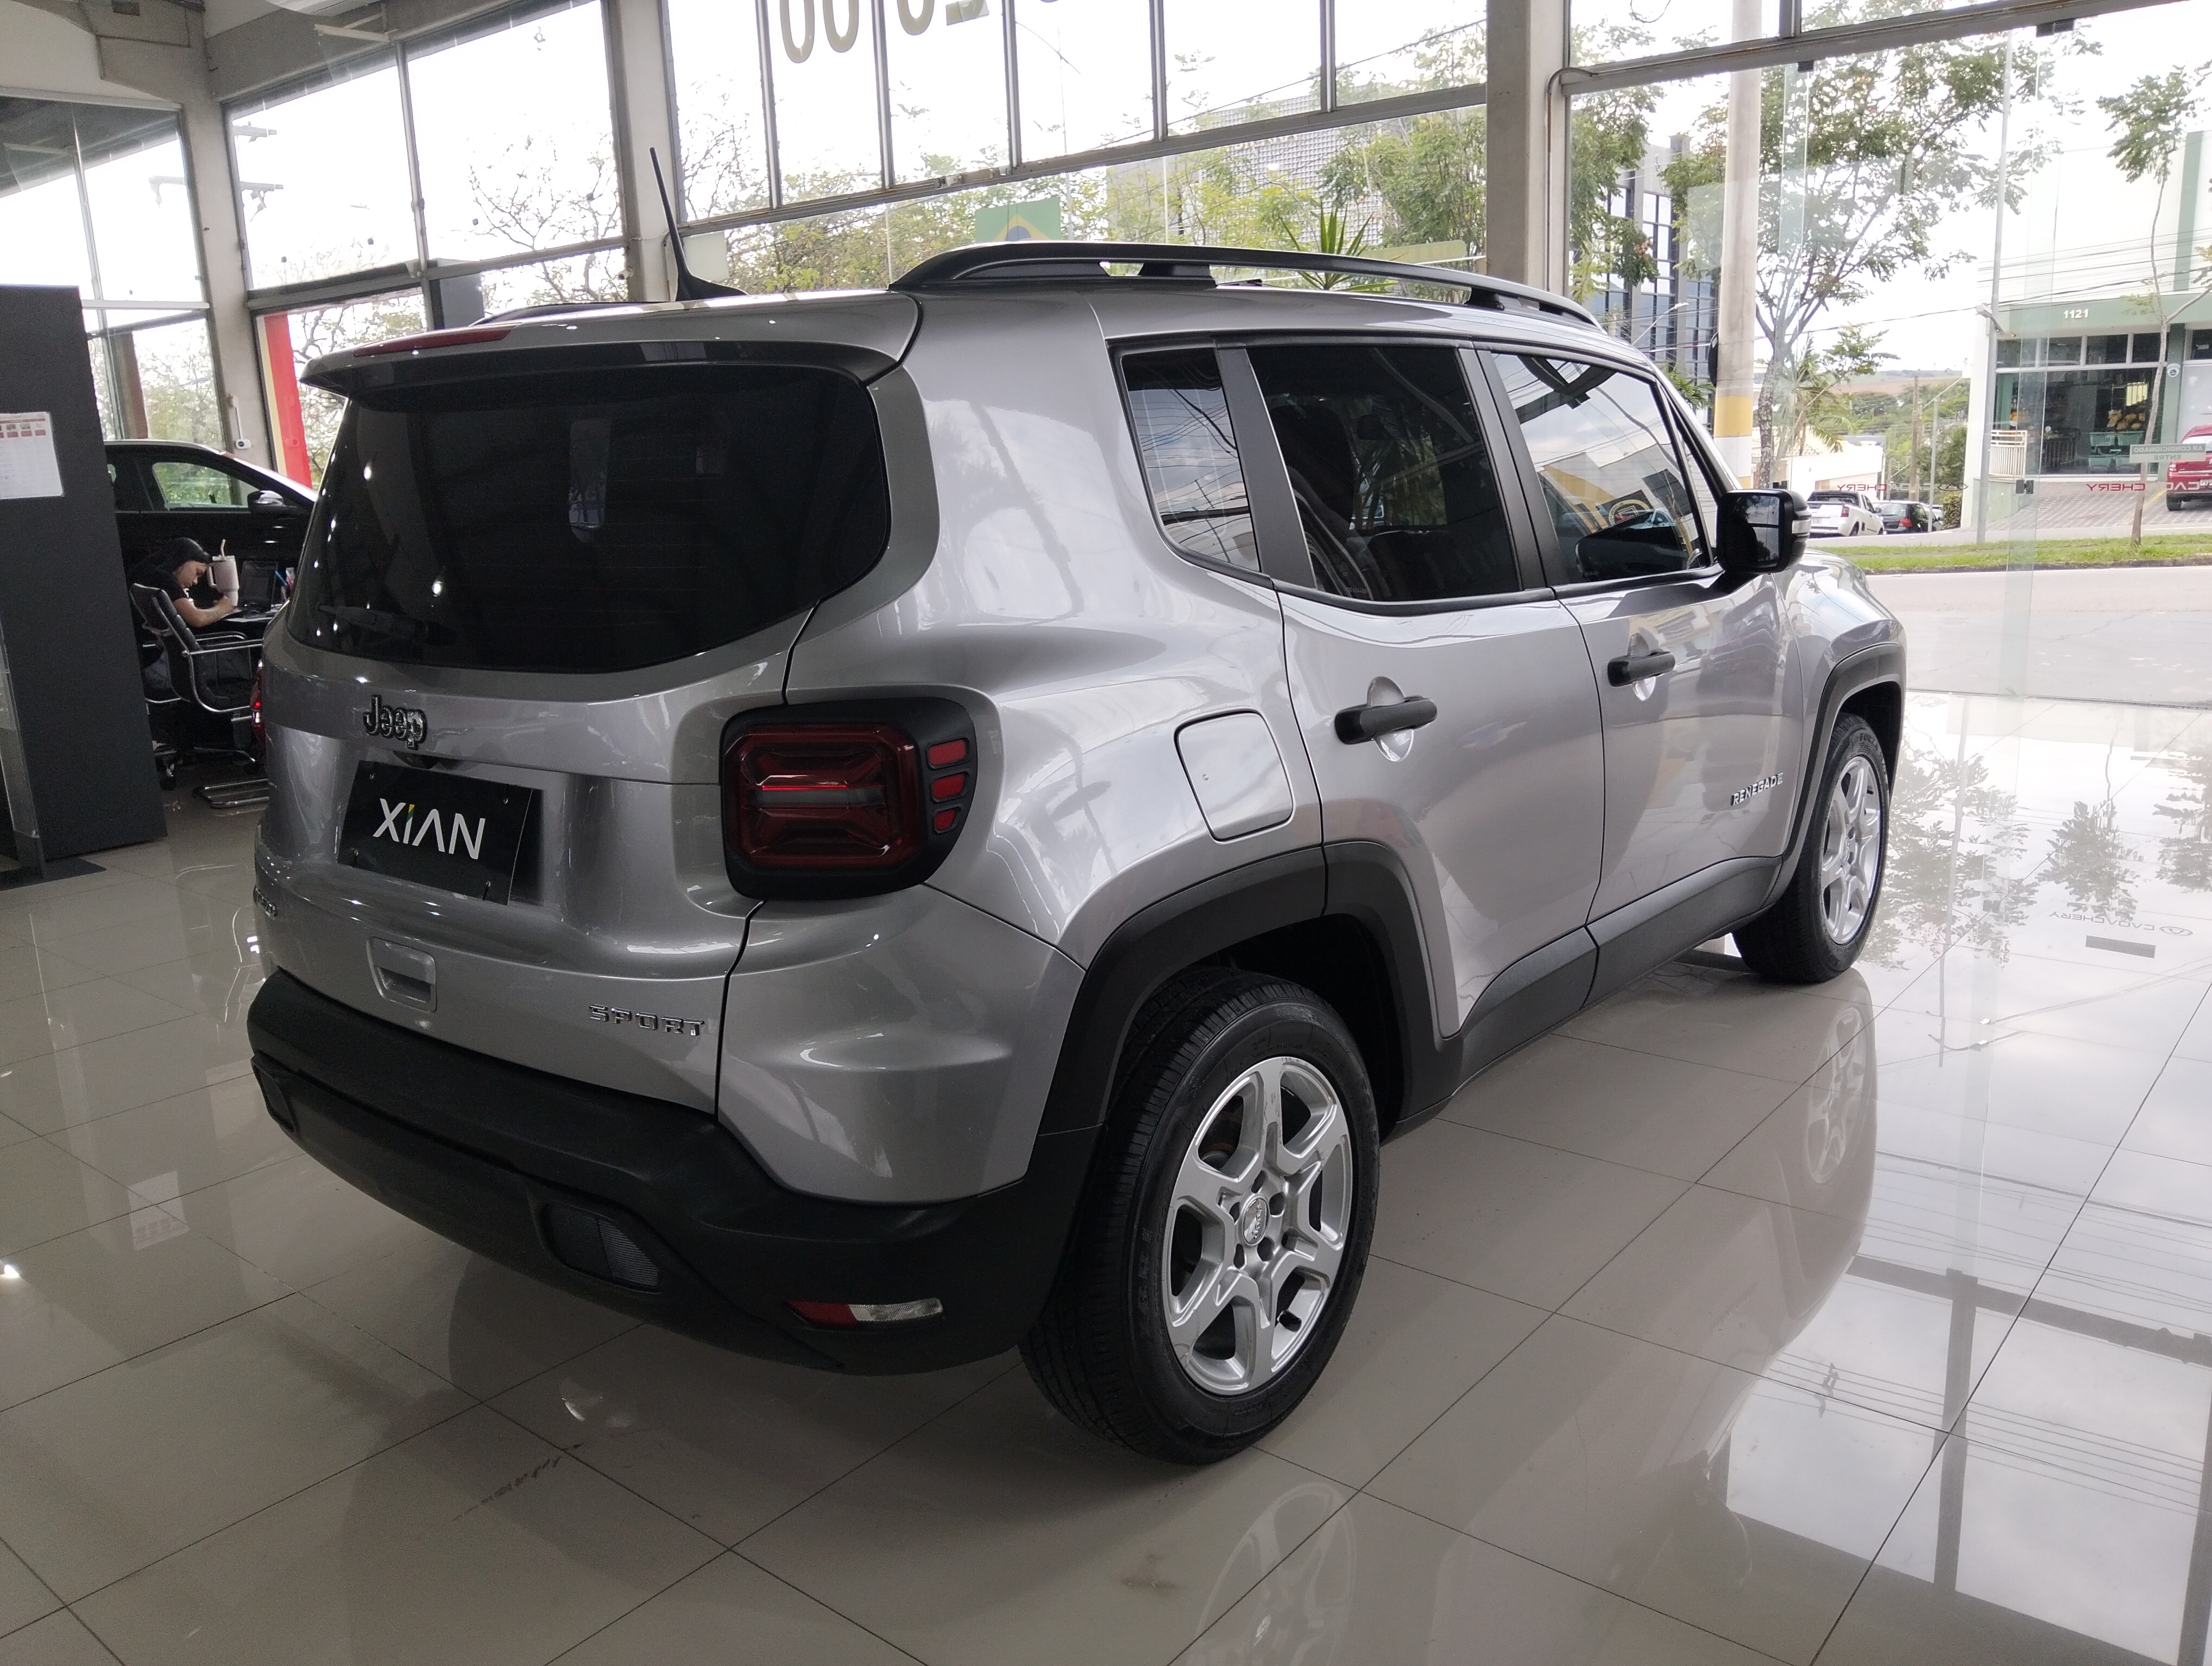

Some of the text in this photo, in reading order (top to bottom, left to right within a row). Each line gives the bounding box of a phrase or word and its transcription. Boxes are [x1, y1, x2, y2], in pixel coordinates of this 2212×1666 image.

[2063, 308, 2089, 319] 1121
[363, 694, 428, 750] Jeep
[1730, 772, 1784, 806] RENEGADE
[372, 798, 486, 860] XIAN
[2049, 911, 2105, 924] CHERY
[589, 1004, 705, 1036] SPORT
[1251, 1203, 1263, 1240] Jeep
